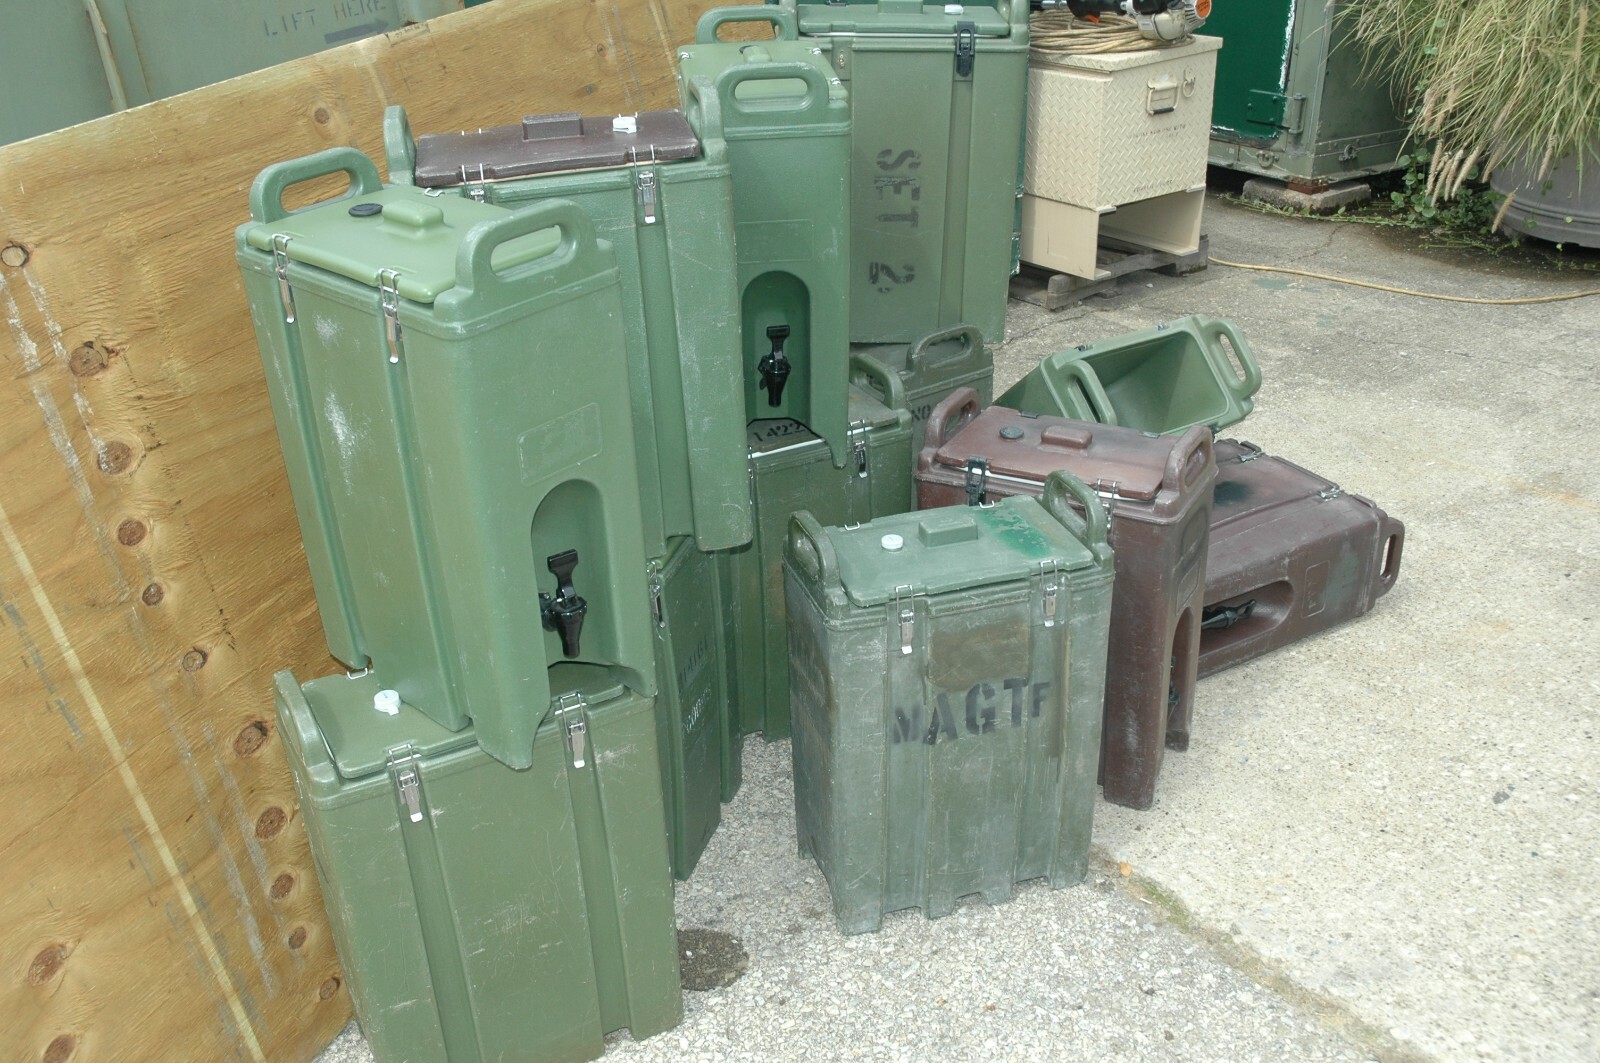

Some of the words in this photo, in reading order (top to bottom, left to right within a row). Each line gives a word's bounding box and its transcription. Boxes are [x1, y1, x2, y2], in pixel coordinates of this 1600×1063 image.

[263, 9, 315, 36] LIFT
[333, 0, 386, 20] HERE
[873, 148, 921, 228] SET
[893, 677, 1051, 746] MAGTF
